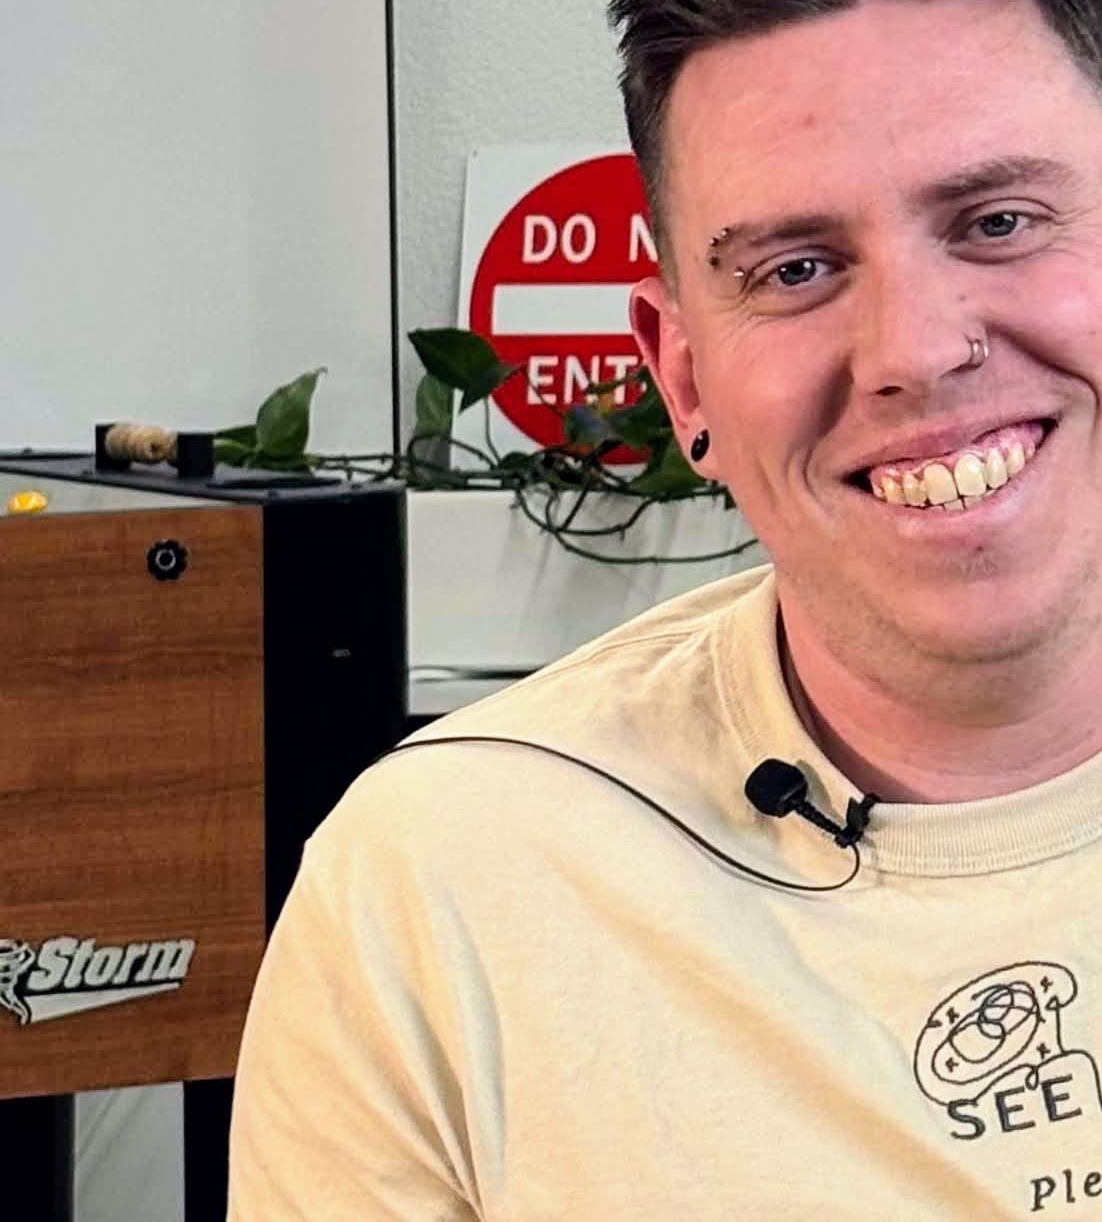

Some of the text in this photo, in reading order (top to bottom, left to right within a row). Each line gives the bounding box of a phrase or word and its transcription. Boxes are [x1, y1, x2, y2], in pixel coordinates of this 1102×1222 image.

[522, 213, 597, 264] DO
[28, 936, 195, 990] Storm
[947, 1074, 1083, 1141] SEE
